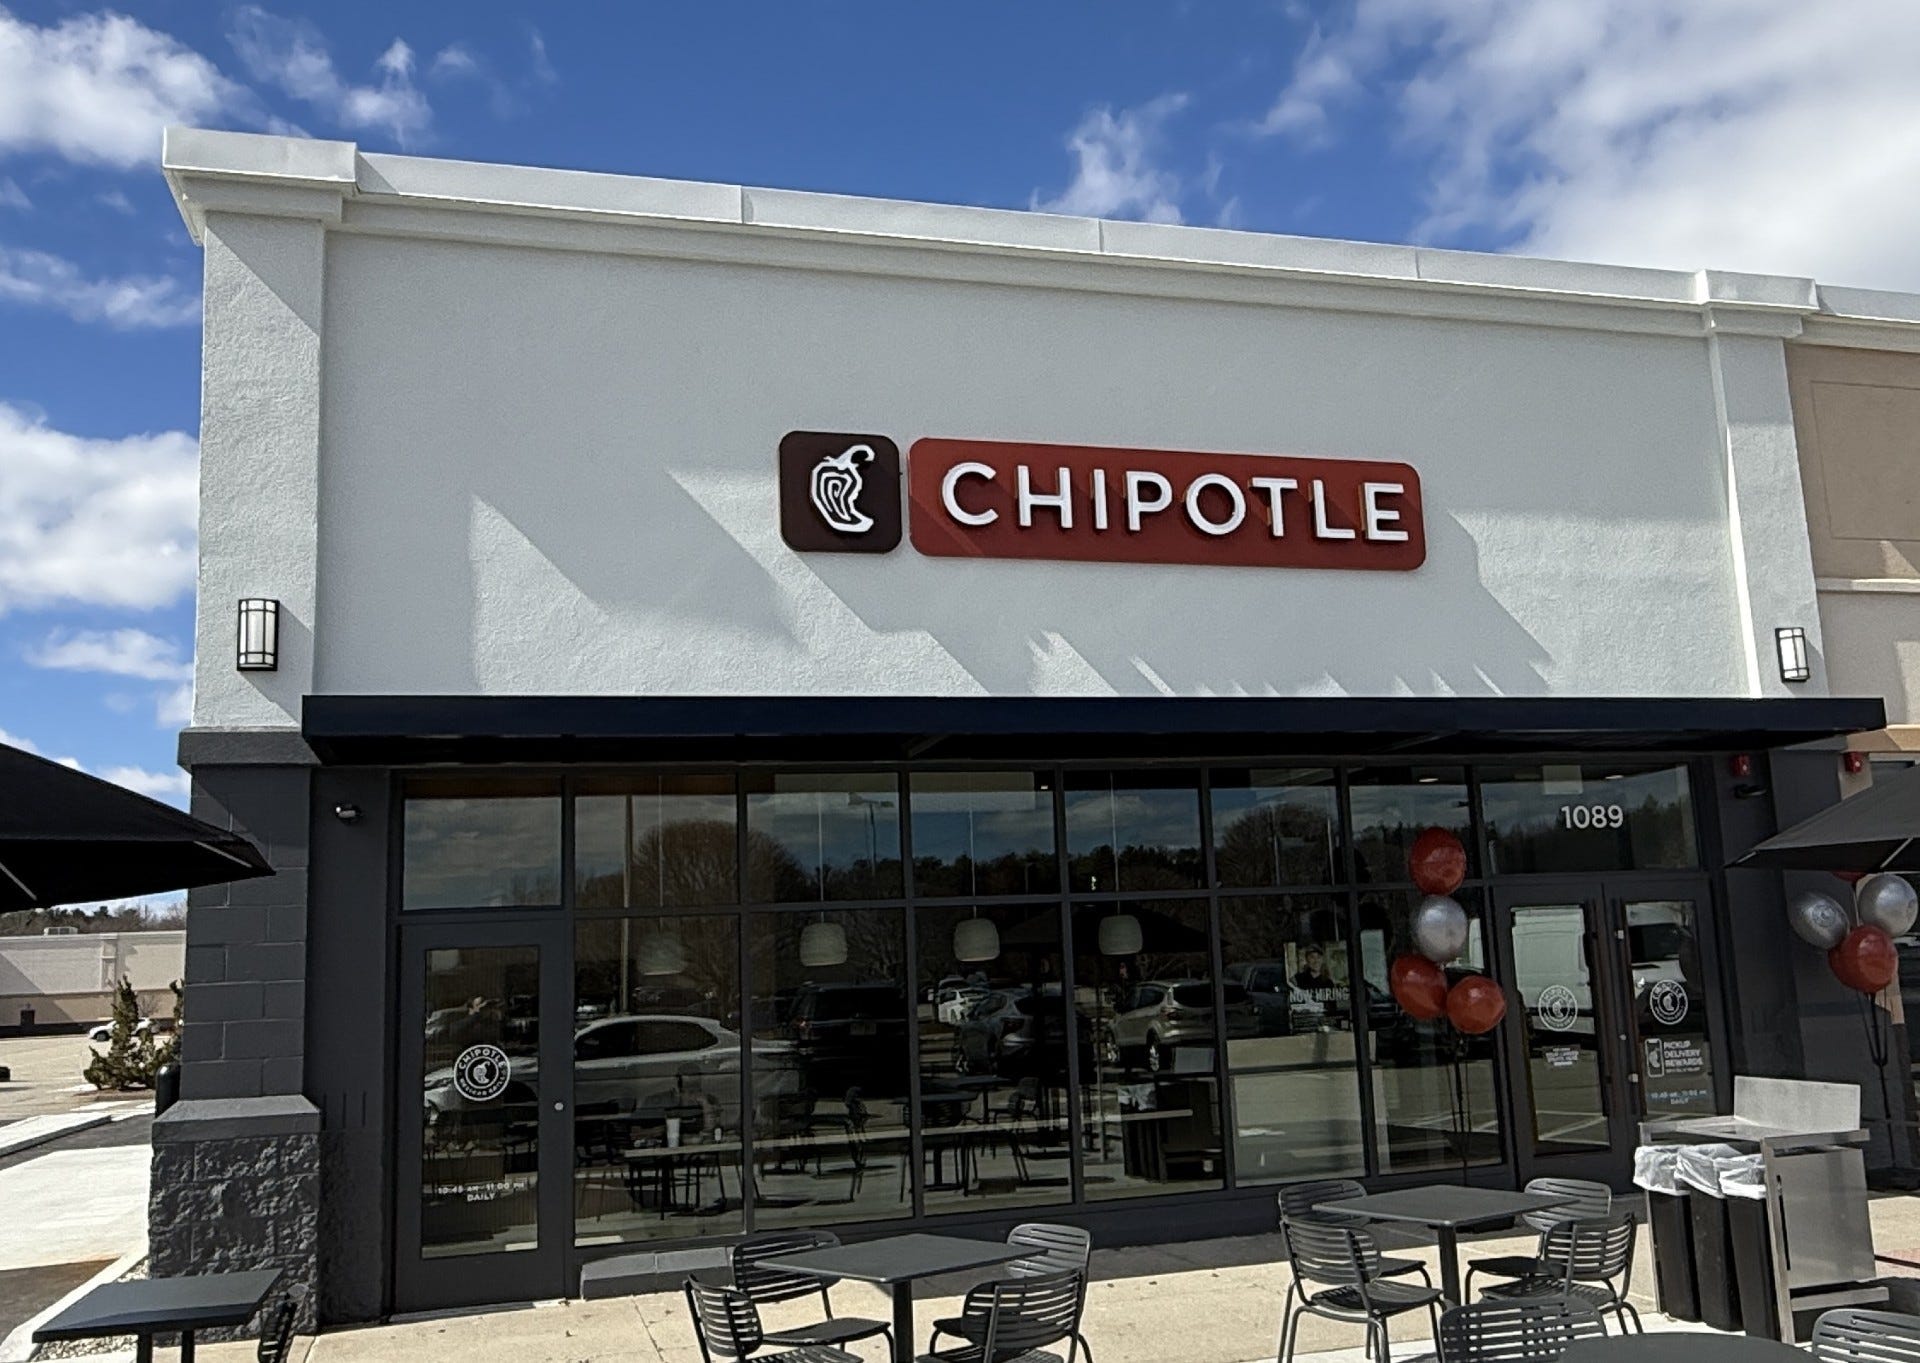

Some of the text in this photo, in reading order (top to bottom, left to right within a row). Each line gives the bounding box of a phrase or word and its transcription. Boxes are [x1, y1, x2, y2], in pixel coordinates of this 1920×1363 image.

[941, 462, 1409, 541] CHIPOTLE
[1561, 805, 1624, 829] 1089
[467, 1192, 495, 1202] DAILY
